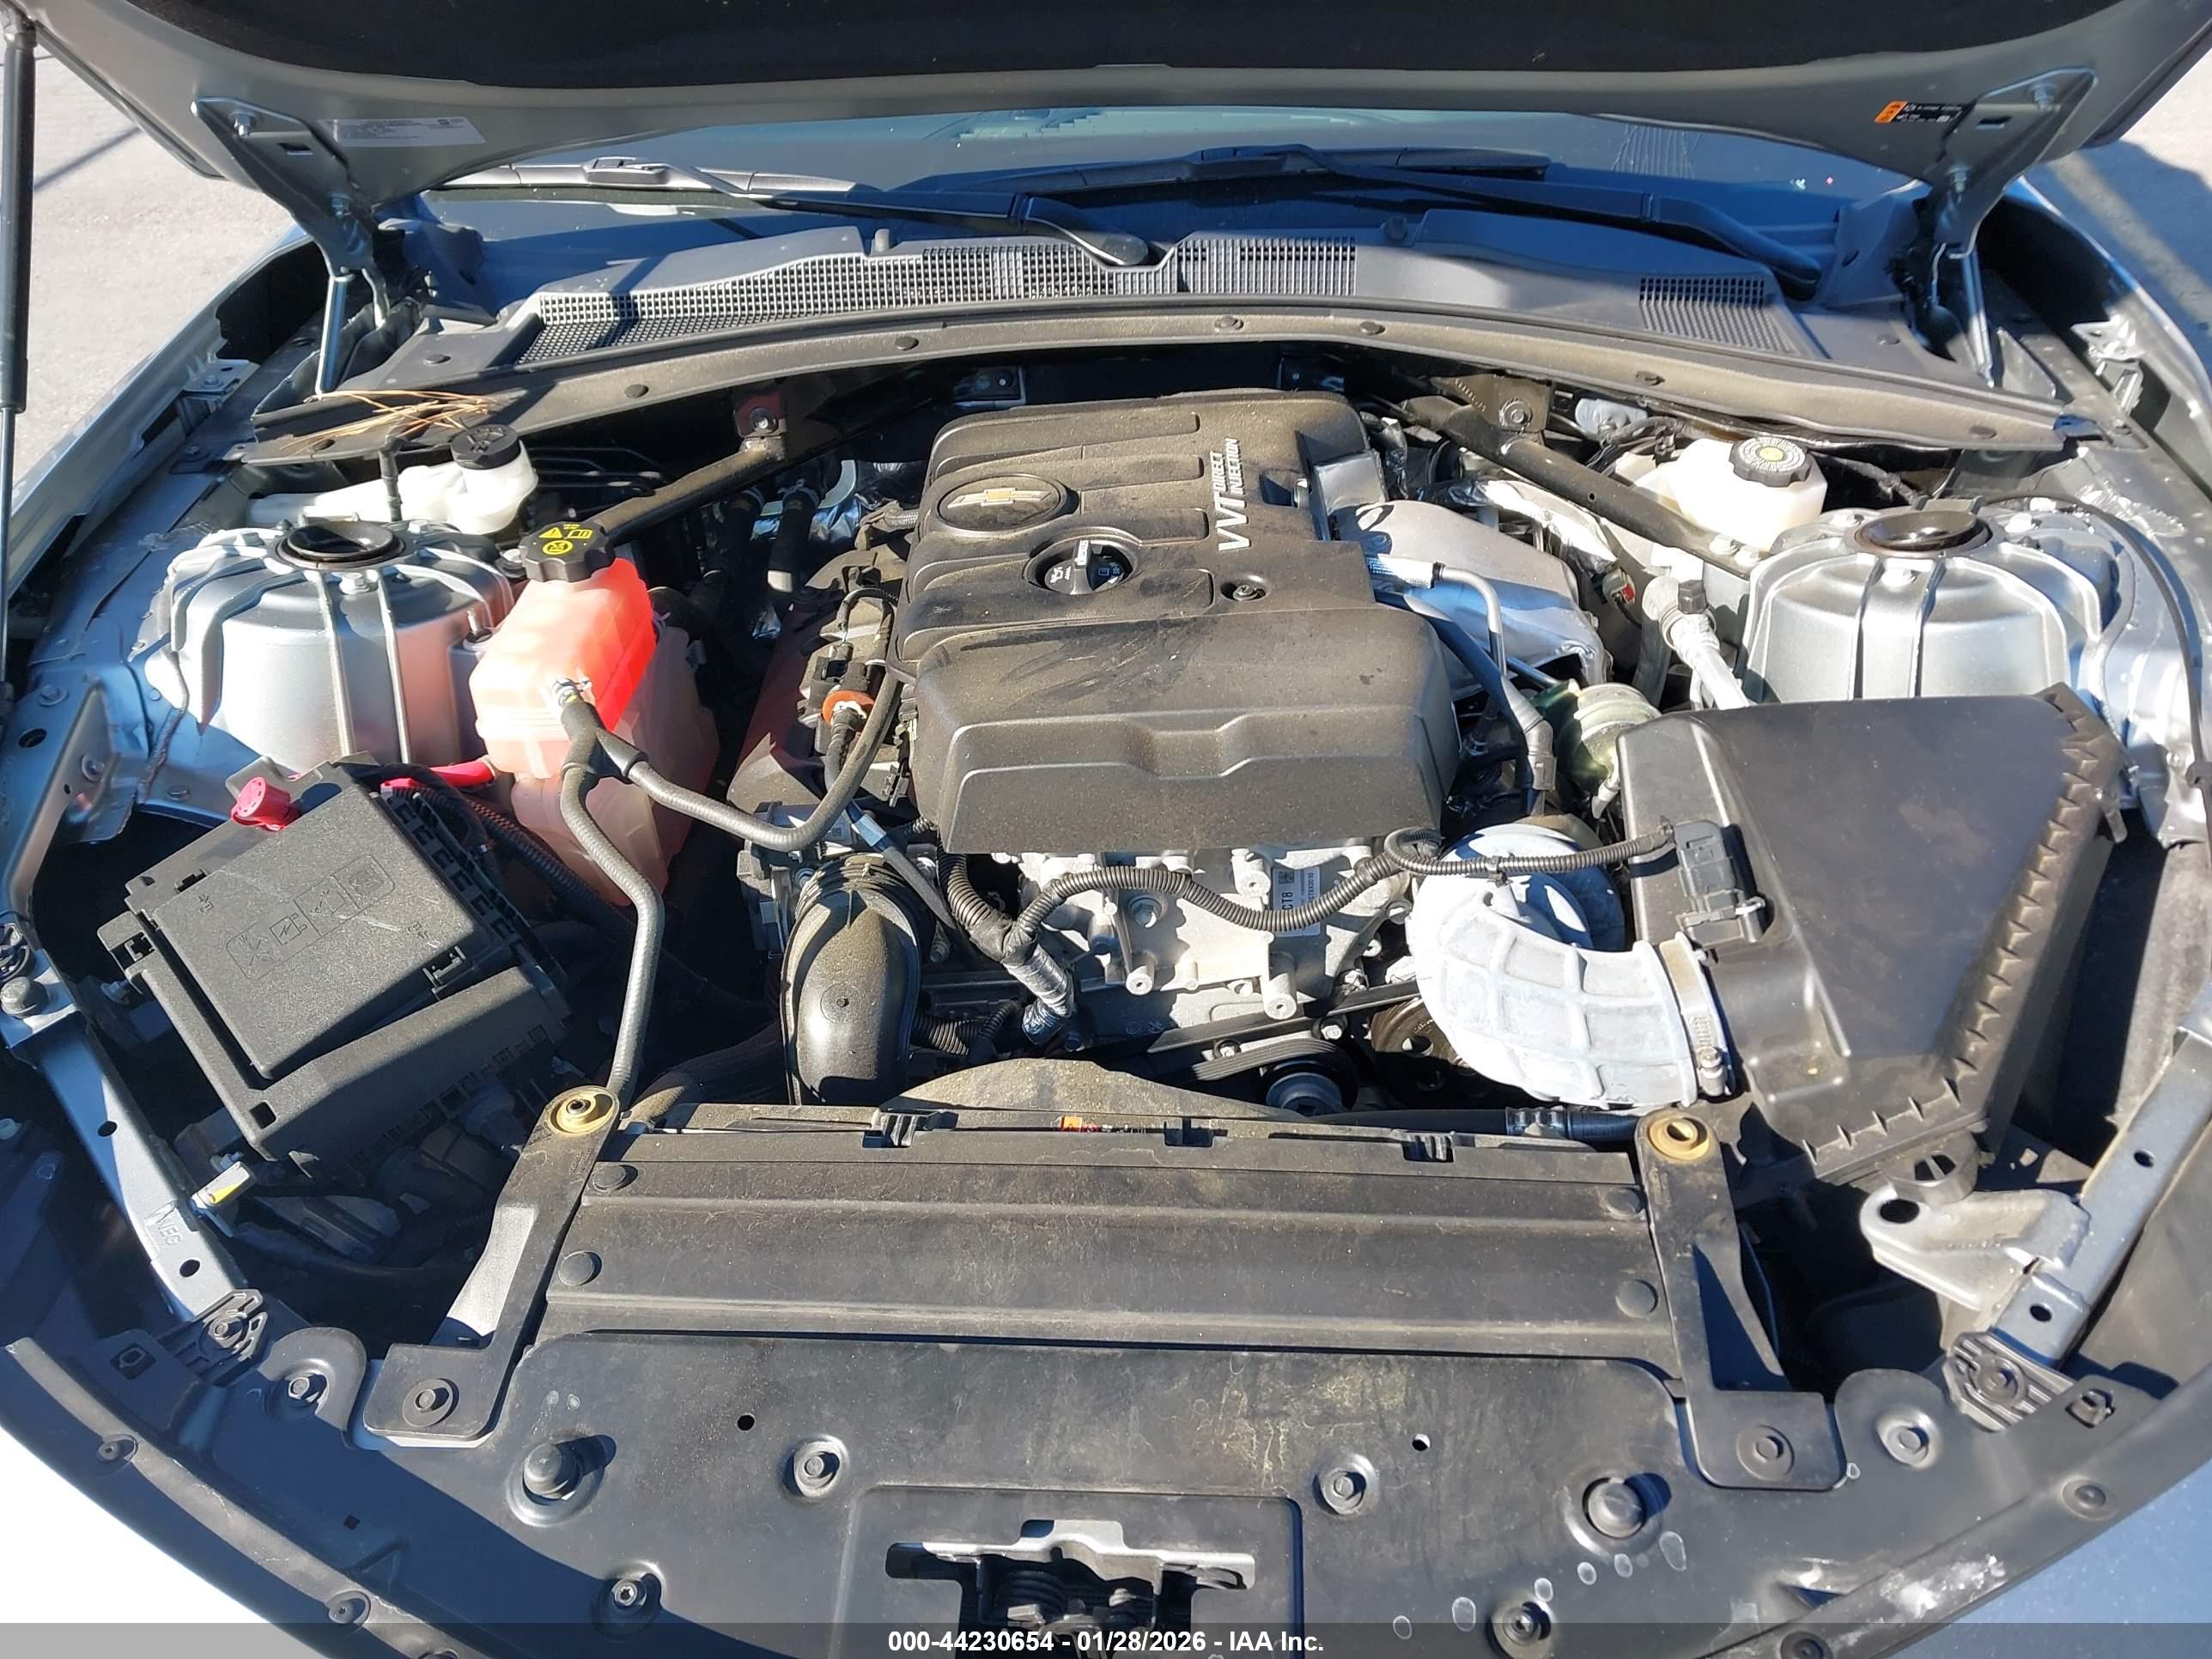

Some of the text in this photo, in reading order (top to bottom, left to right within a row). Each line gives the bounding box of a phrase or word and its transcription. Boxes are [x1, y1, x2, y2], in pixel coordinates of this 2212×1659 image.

[1210, 451, 1226, 492] DIRECT
[1225, 438, 1244, 495] INJECTION
[1213, 489, 1251, 551] VVT
